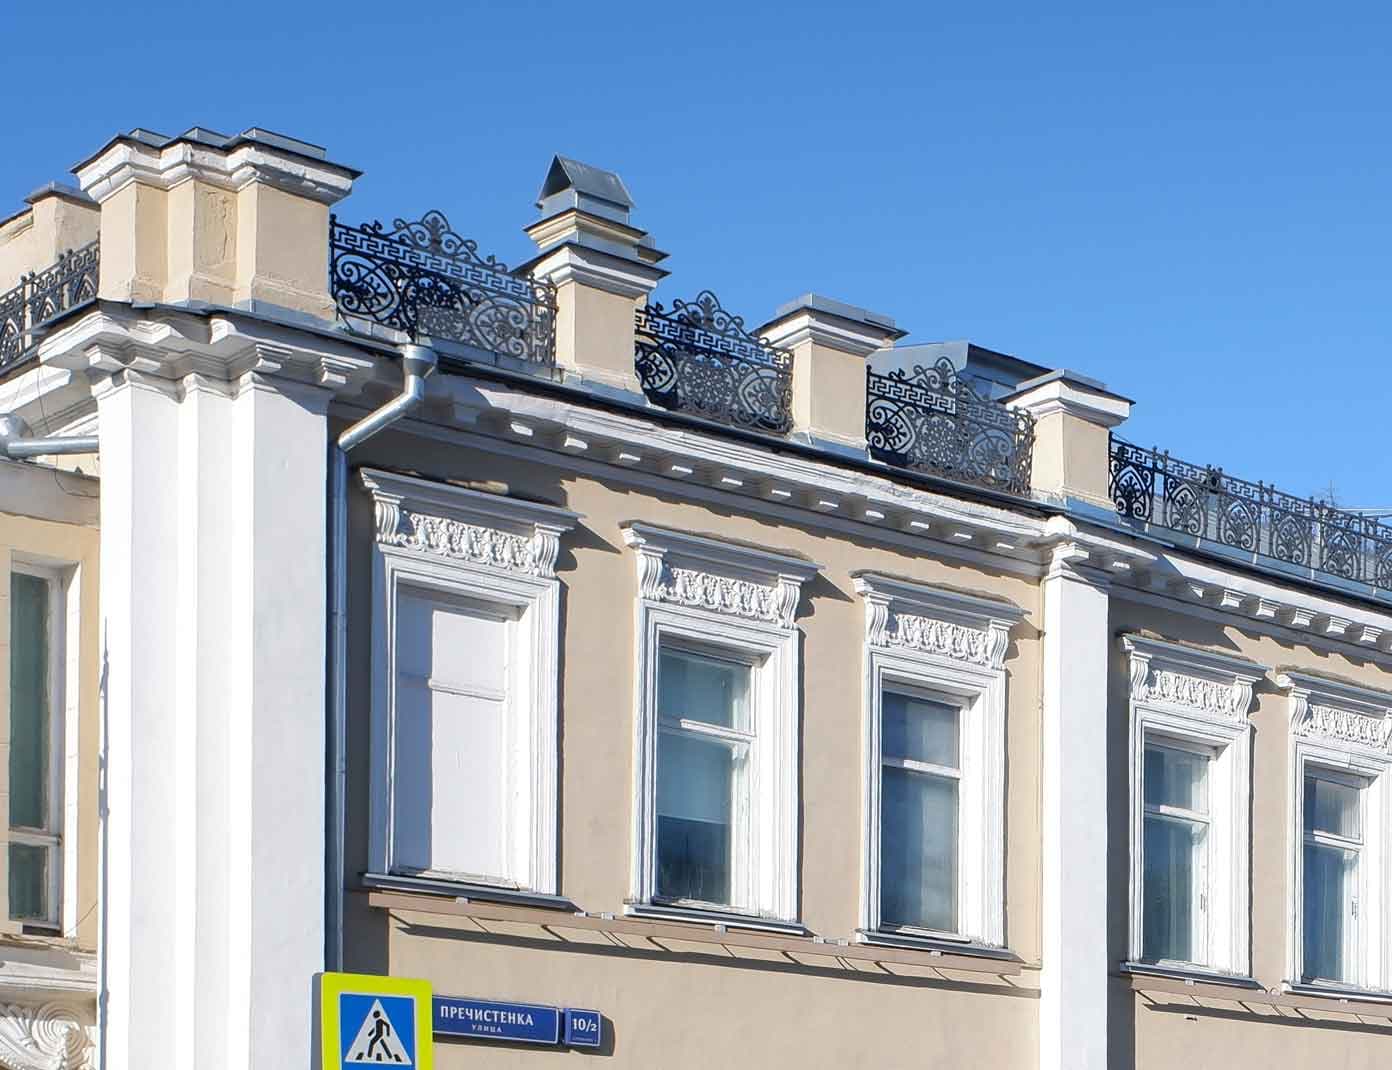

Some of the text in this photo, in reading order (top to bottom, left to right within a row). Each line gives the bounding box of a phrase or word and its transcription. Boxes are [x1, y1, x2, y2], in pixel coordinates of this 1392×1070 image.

[440, 1005, 534, 1026] ПРЕЧИСТЕНКА
[472, 1023, 503, 1033] УЛИЦА
[573, 1018, 598, 1032] 10/2
